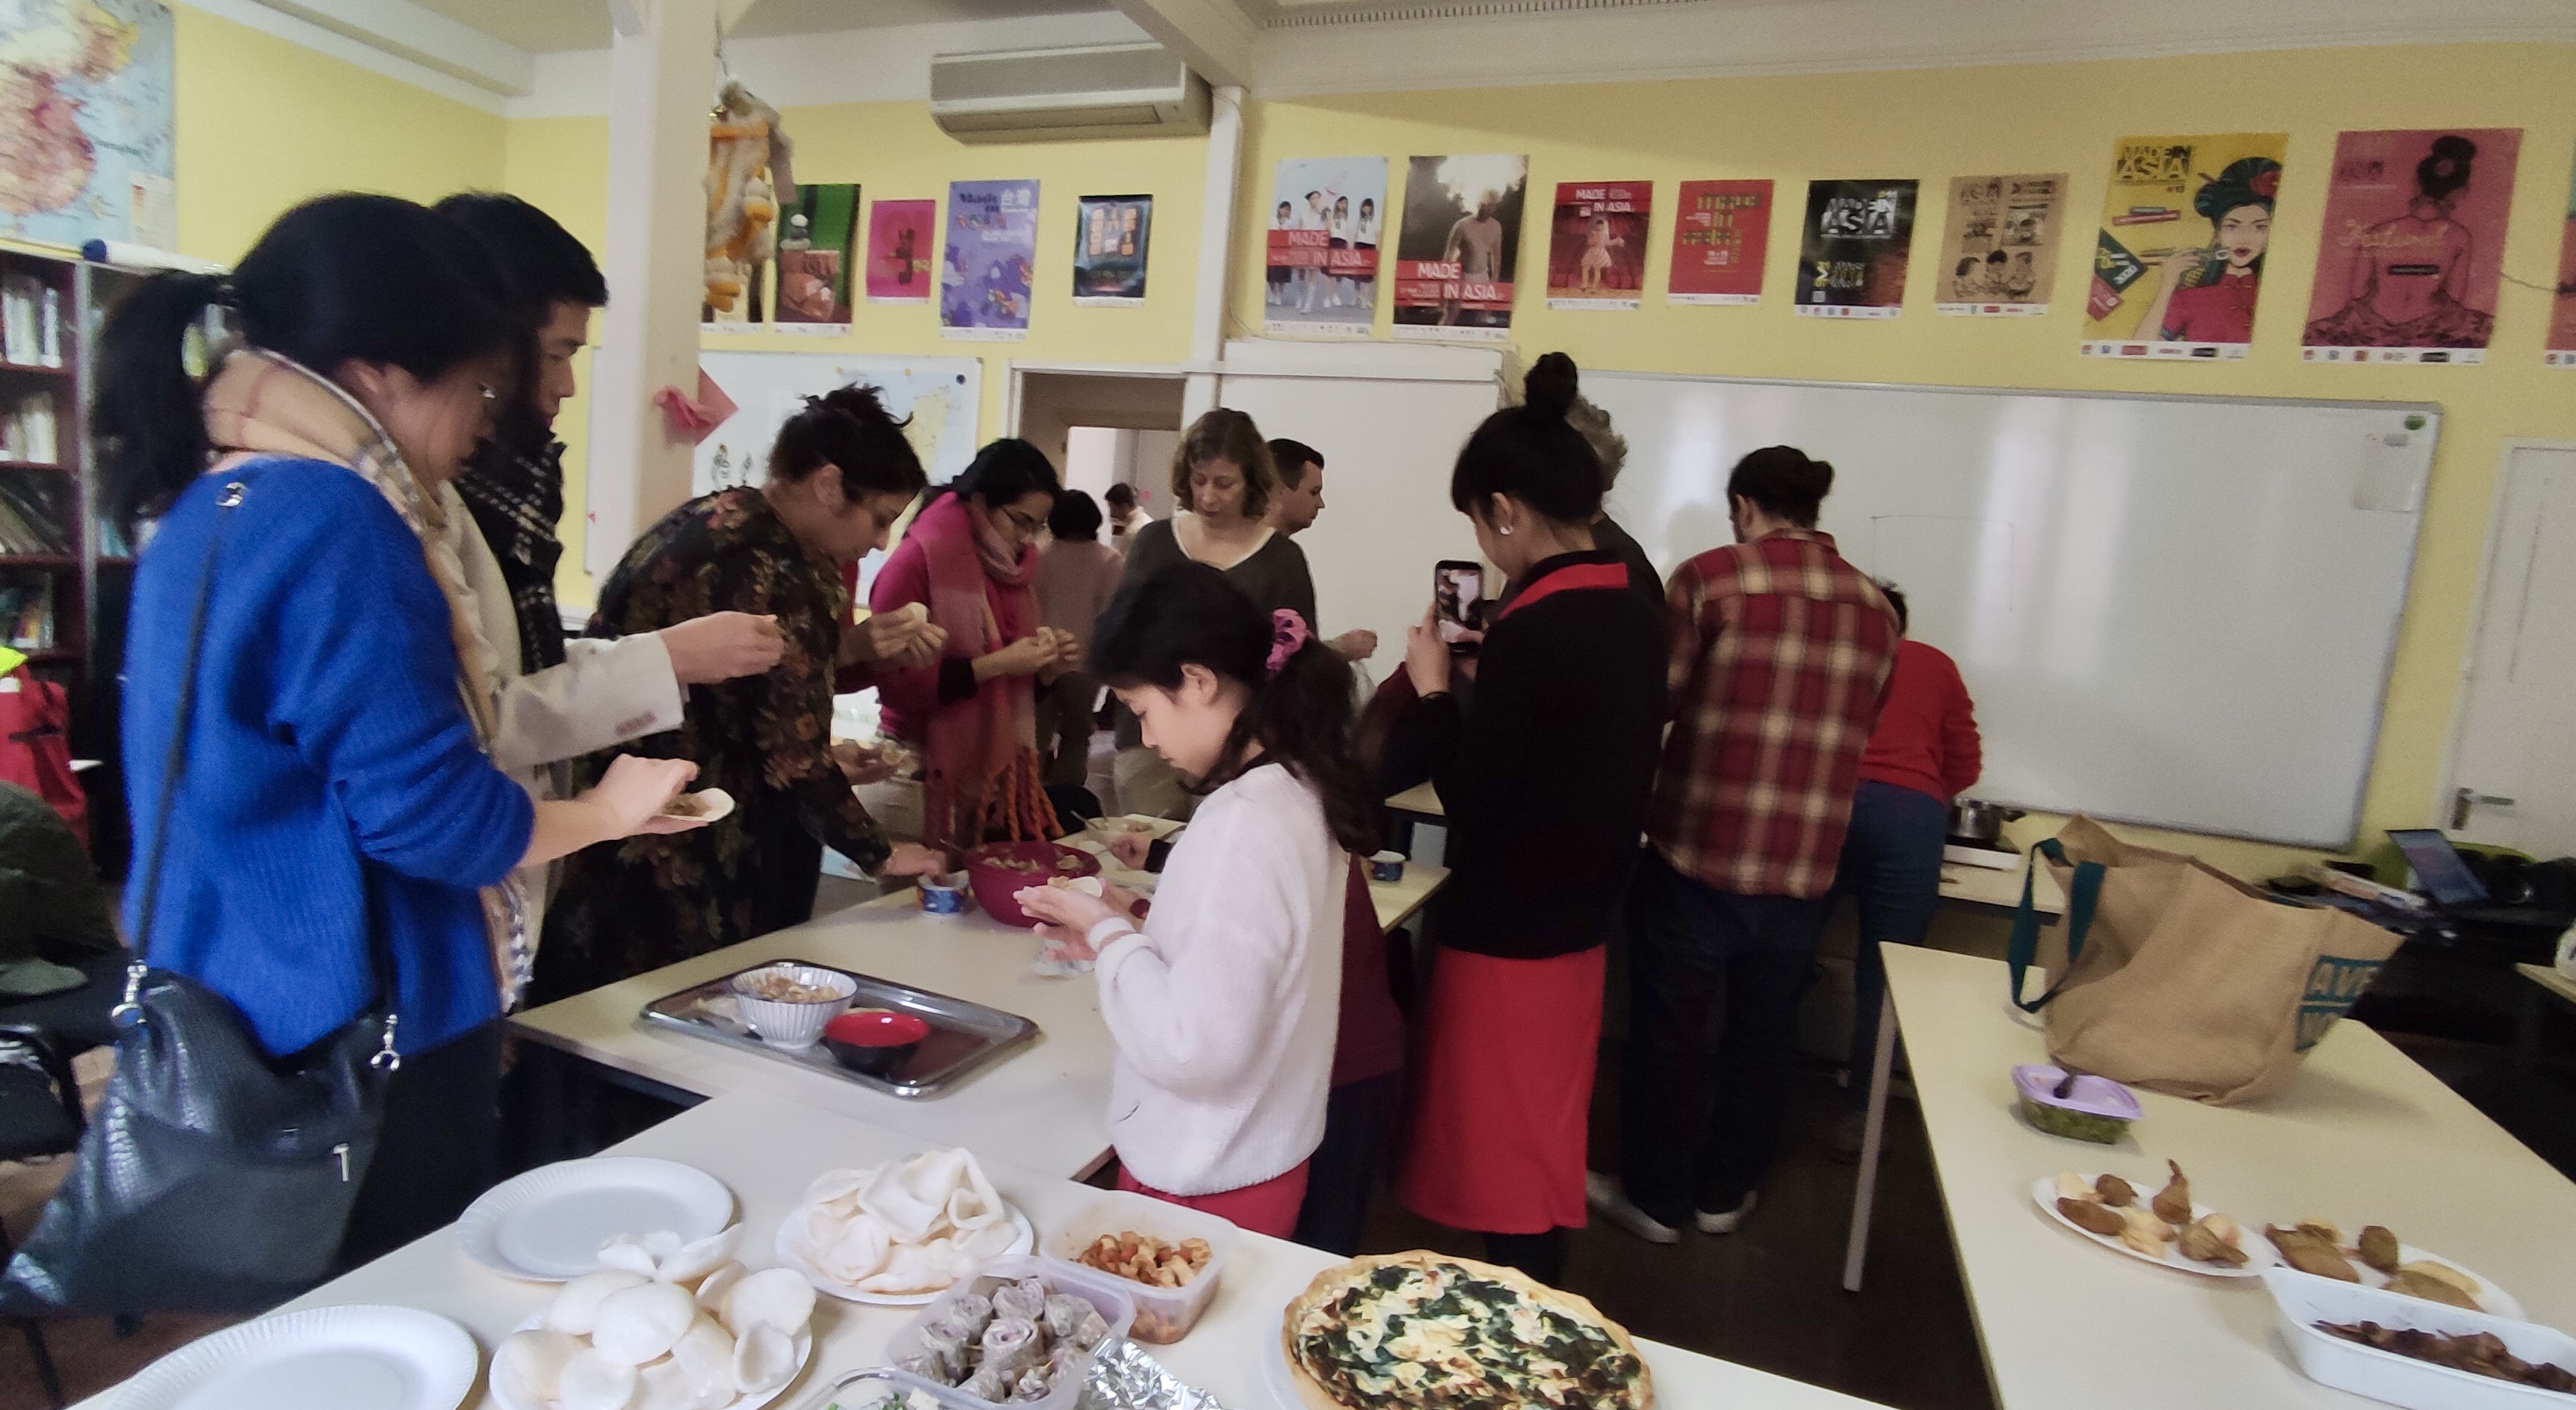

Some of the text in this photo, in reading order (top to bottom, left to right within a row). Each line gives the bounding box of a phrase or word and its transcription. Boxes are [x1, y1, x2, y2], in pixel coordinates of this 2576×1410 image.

[1575, 188, 1606, 200] MADE
[1593, 201, 1631, 212] IN ASIA
[1288, 231, 1329, 247] MADE
[1312, 250, 1329, 265] IN
[1331, 249, 1363, 267] ASIA
[1418, 262, 1461, 279] MADE
[1443, 283, 1460, 299] IN
[1462, 284, 1496, 300] ASIA
